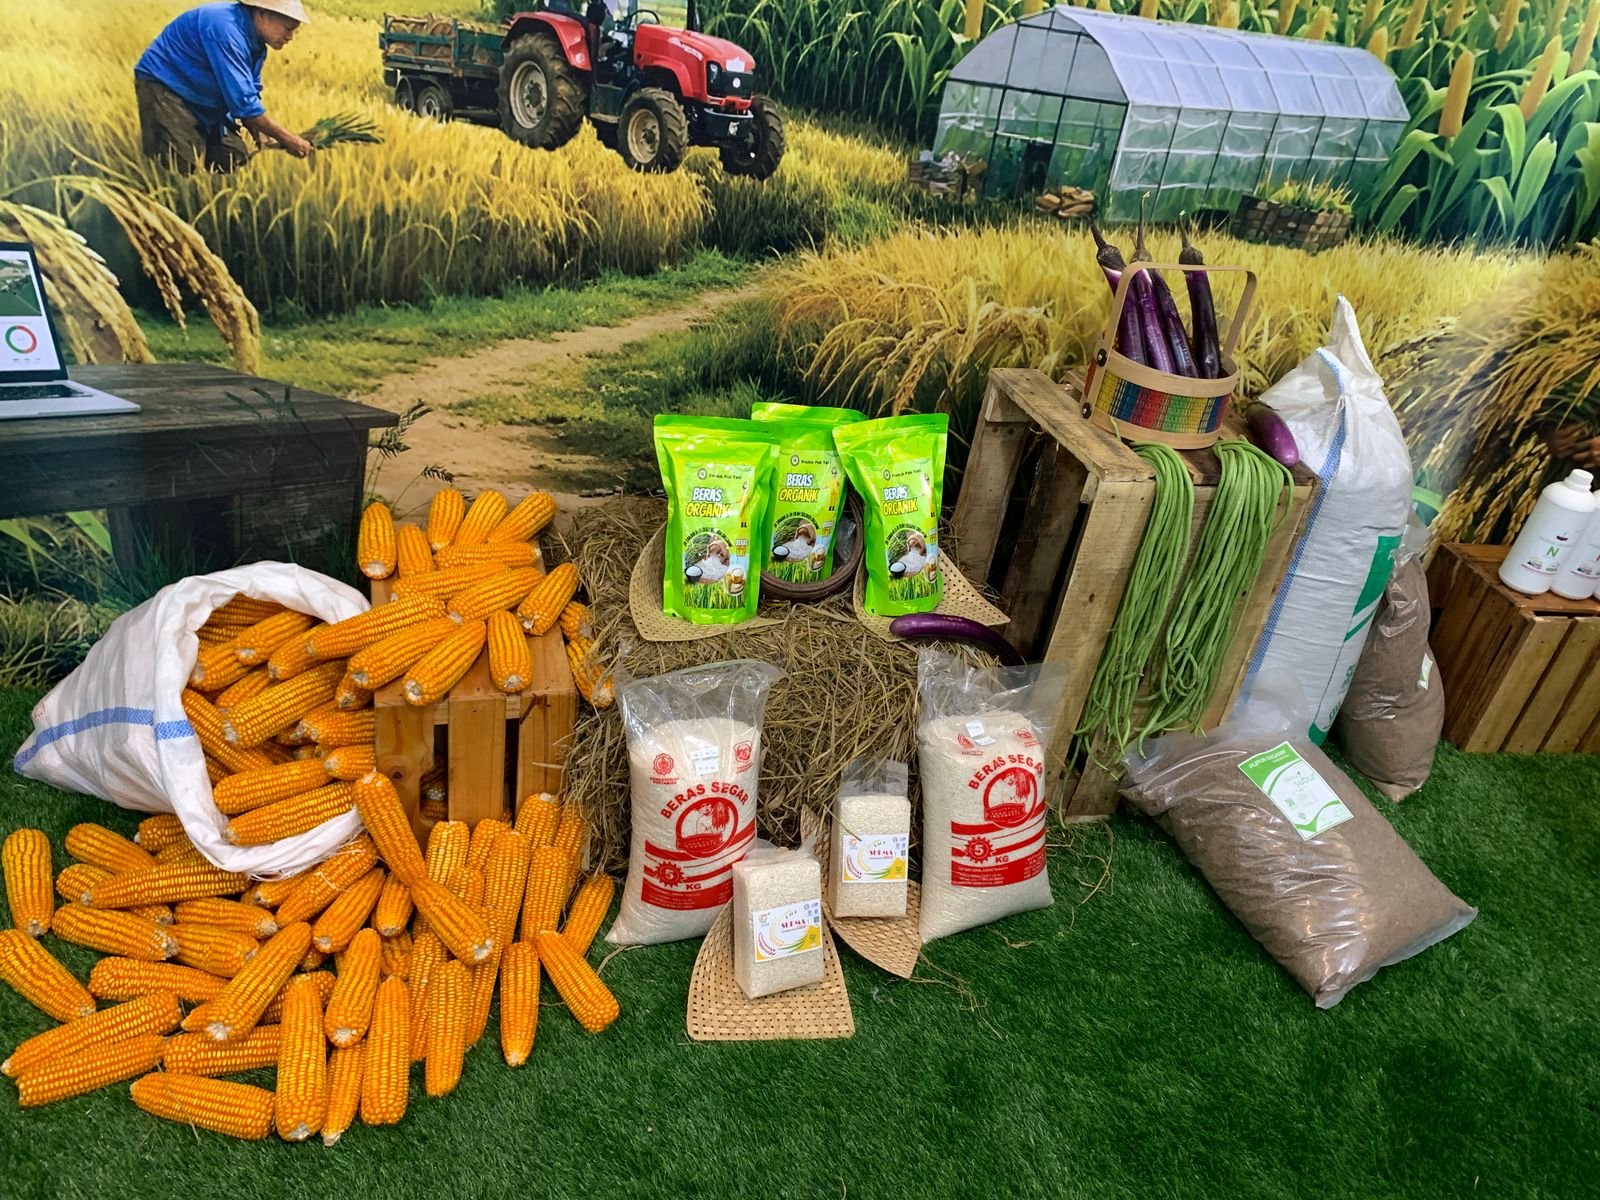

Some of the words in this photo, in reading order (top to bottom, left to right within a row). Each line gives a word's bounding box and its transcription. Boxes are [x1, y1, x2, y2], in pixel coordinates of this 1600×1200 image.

[786, 473, 814, 487] BERAS
[692, 487, 723, 501] BERAS
[779, 487, 820, 503] ORGANIK
[883, 485, 908, 500] BERAS
[686, 502, 730, 517] ORGANIK
[883, 497, 918, 516] ORGANIK
[1546, 546, 1560, 557] N
[968, 756, 1006, 789] BERAS
[660, 784, 705, 819] BERAS
[711, 781, 749, 805] SEGAR
[974, 844, 984, 856] 5
[995, 855, 1009, 863] KG
[664, 869, 674, 880] 5
